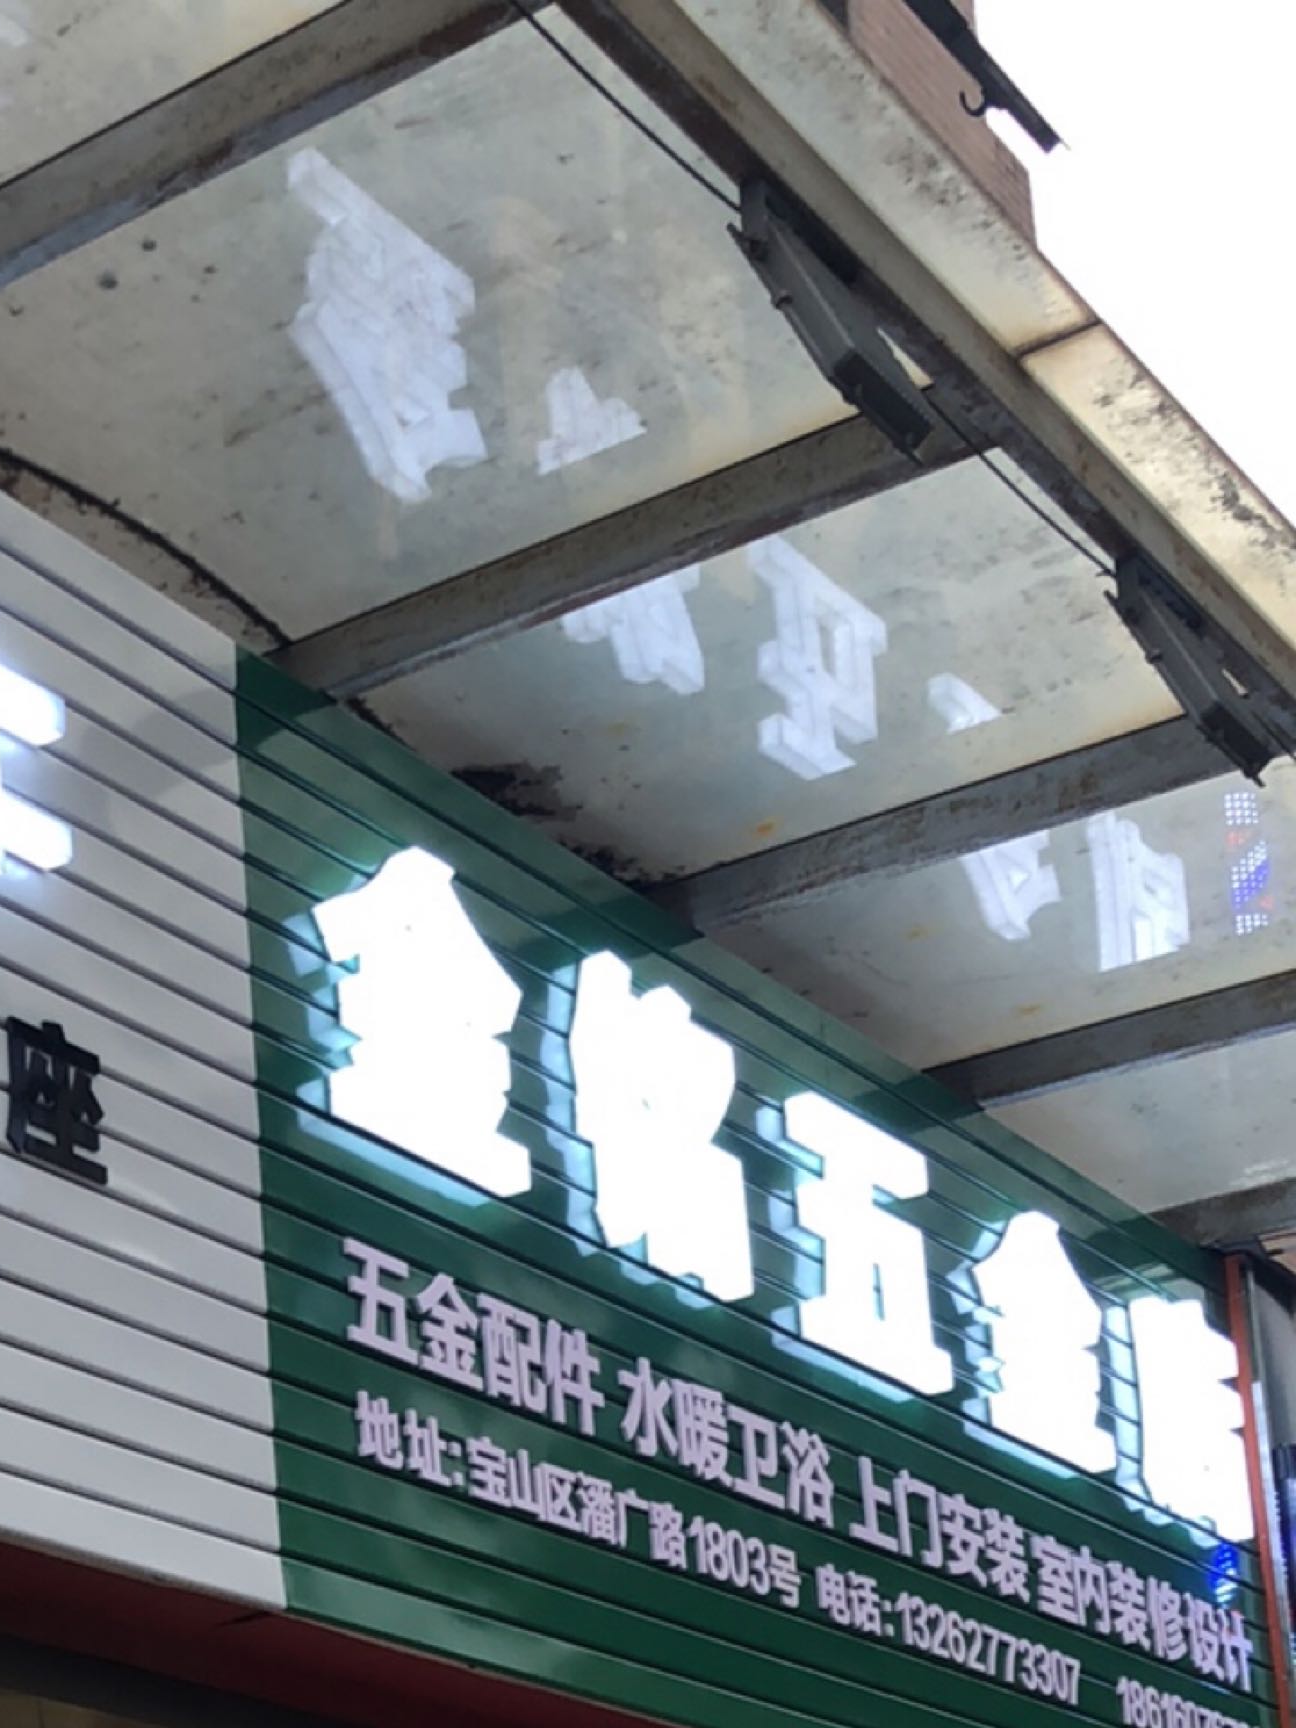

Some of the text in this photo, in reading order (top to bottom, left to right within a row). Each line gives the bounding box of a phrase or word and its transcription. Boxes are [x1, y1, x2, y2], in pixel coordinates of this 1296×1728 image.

[342, 1237, 1254, 1693] 五金配件 水暖卫浴 上门安装 室内装修设计
